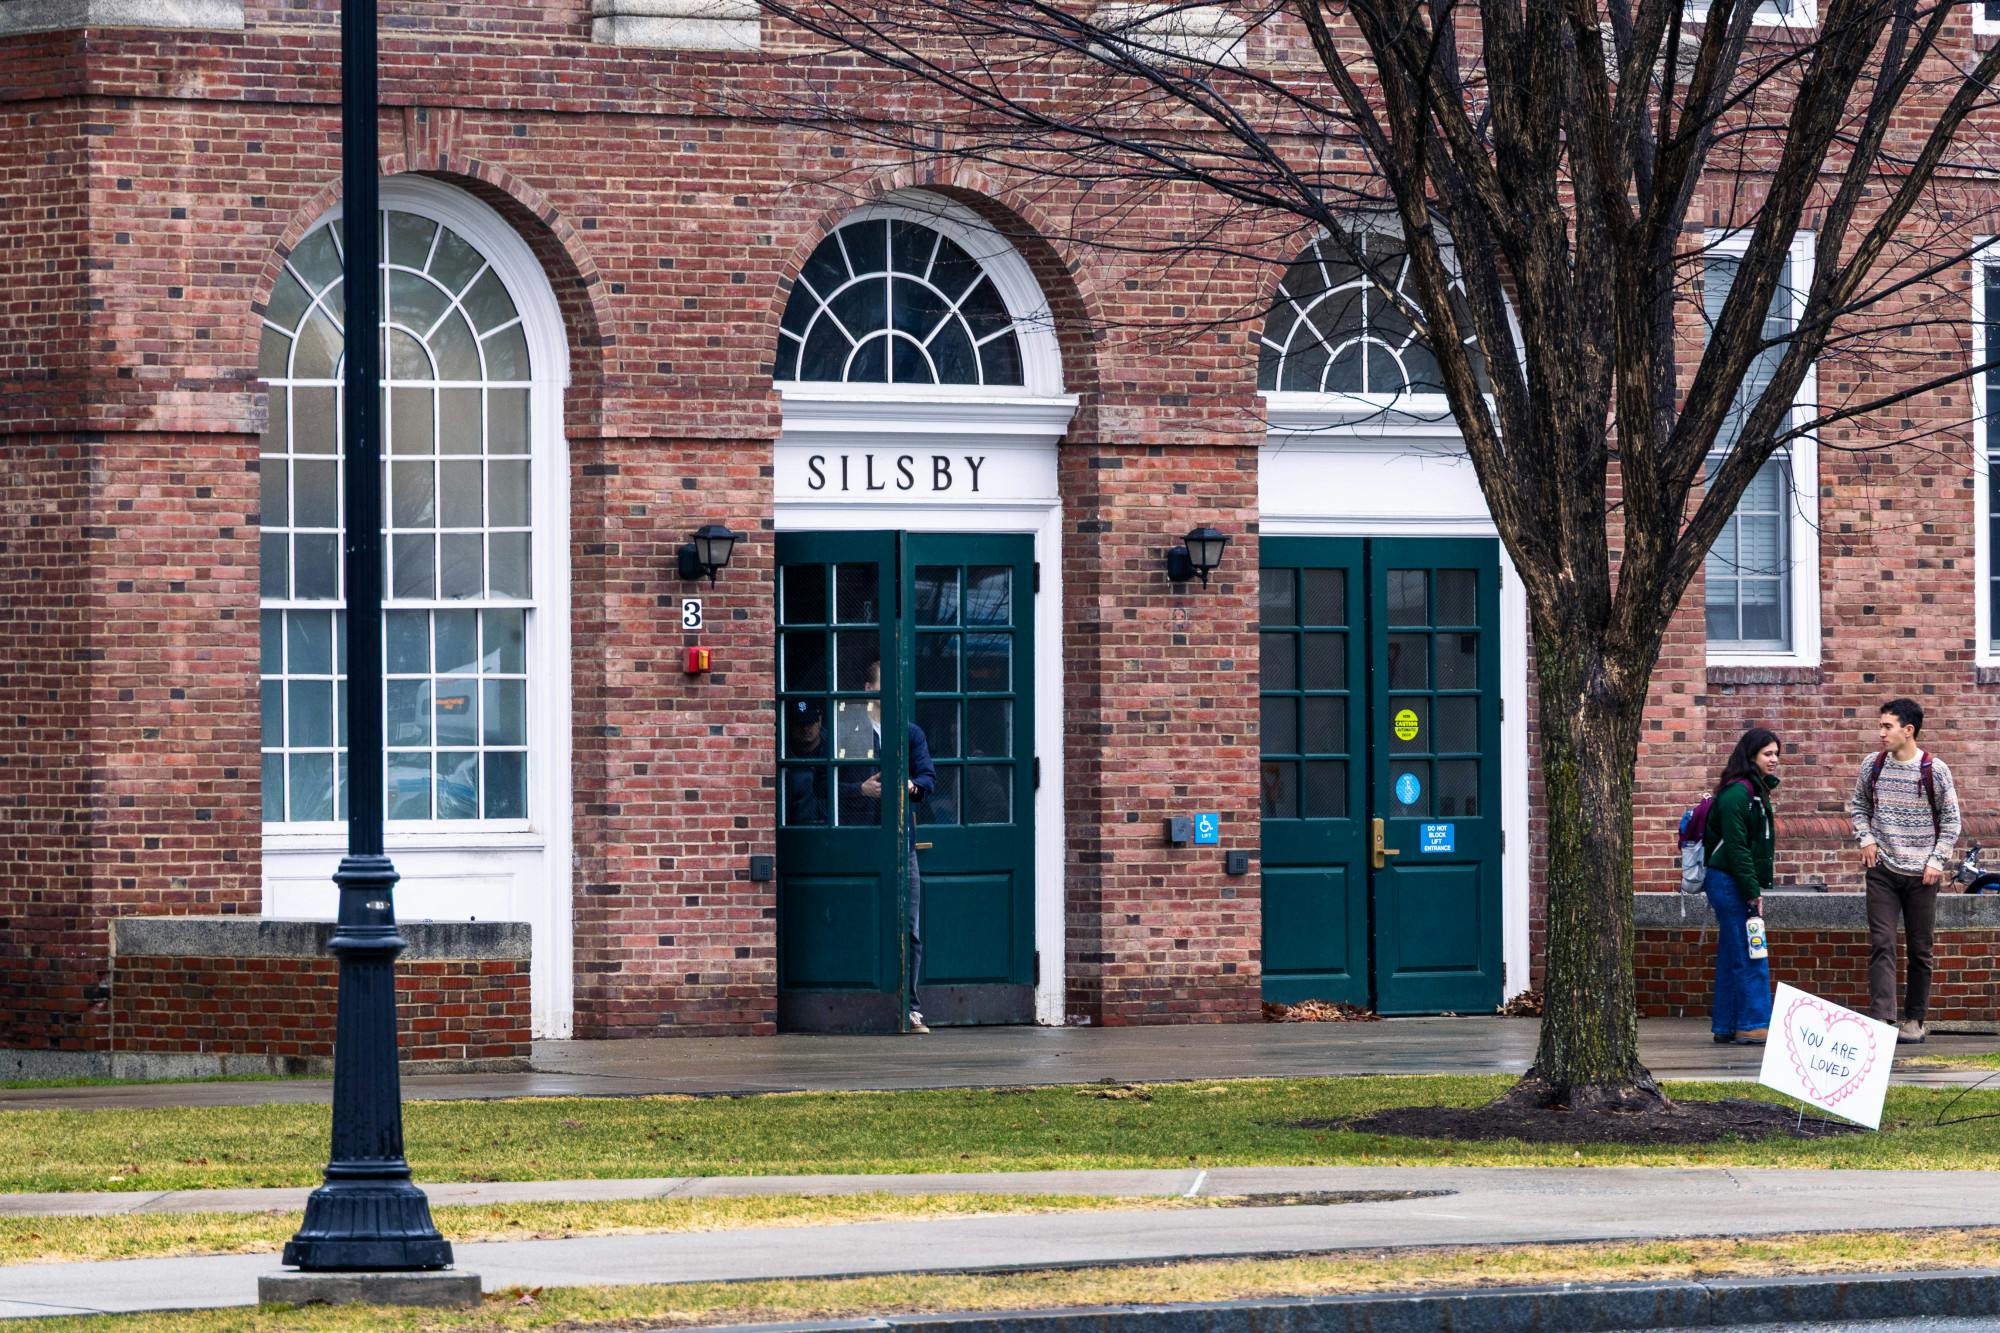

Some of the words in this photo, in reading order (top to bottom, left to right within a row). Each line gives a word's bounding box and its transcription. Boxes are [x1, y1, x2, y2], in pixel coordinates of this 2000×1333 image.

[807, 454, 986, 491] SILSBY
[684, 601, 701, 627] 3
[1799, 1025, 1824, 1048] YOU
[1831, 1042, 1858, 1061] ARE
[1810, 1055, 1850, 1078] LOVED
